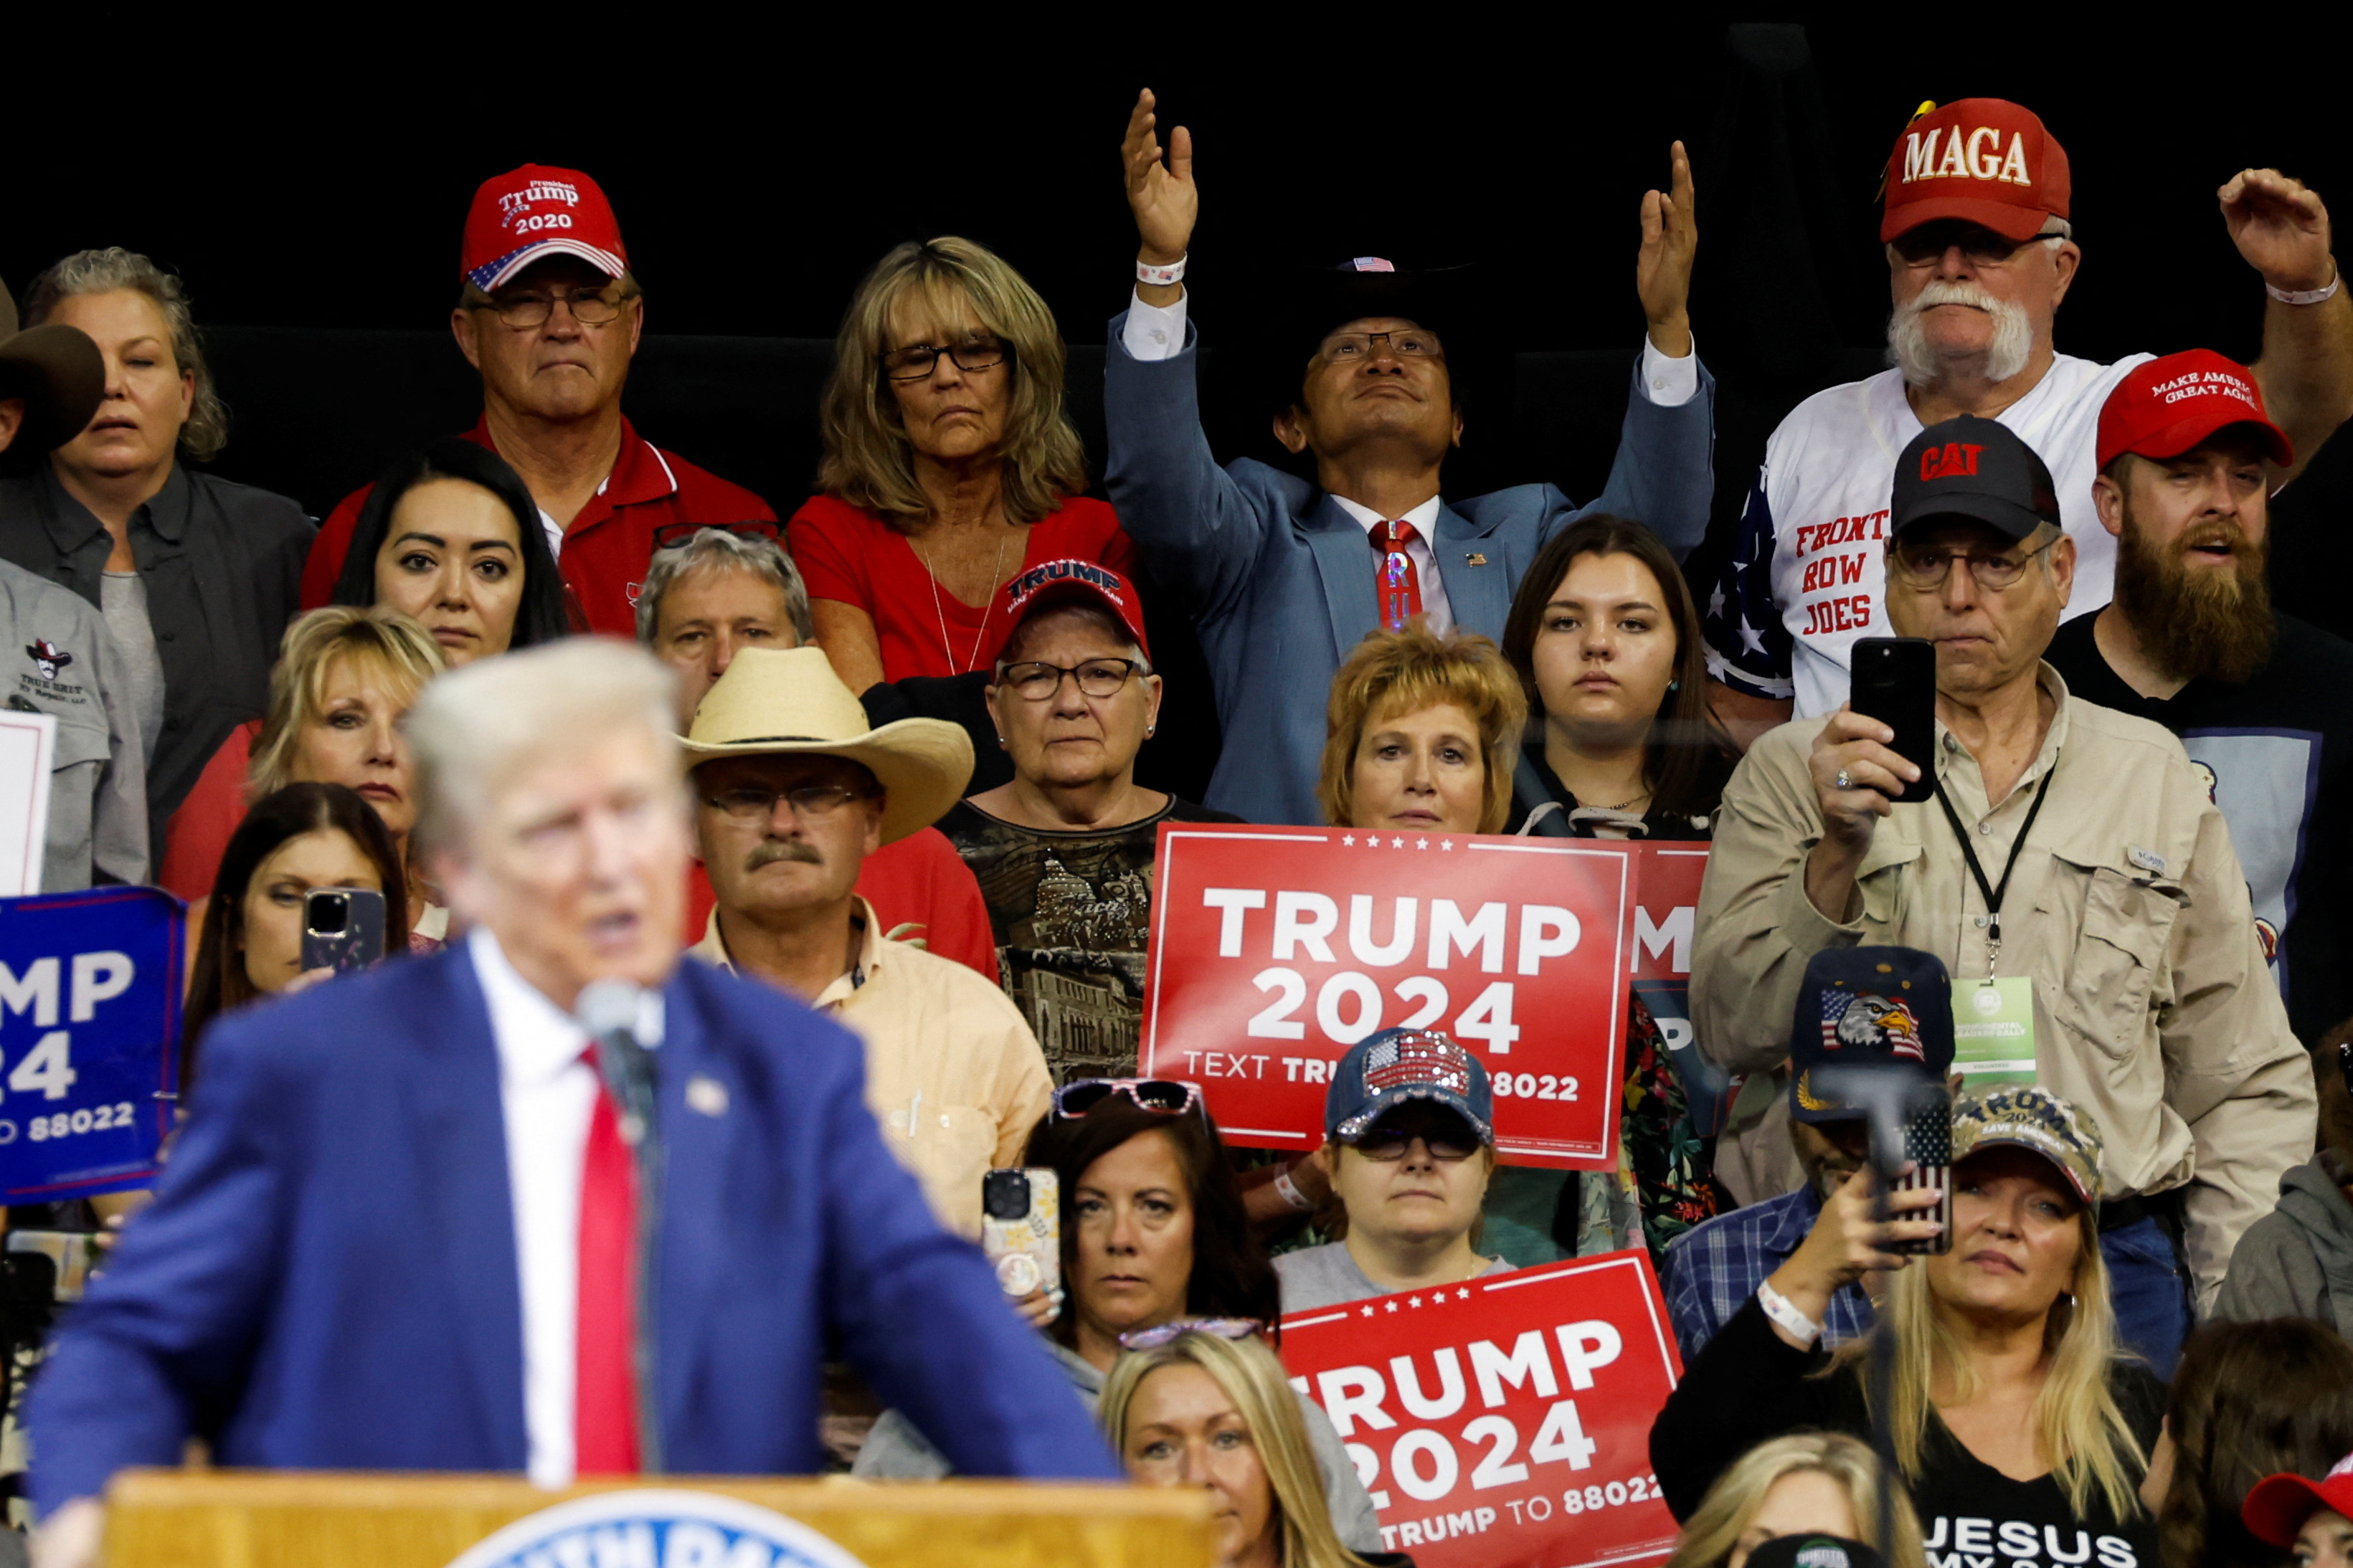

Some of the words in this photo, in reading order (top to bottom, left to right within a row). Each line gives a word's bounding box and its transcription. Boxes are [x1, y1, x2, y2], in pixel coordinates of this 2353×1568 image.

[1902, 124, 2031, 186] MAGA
[498, 186, 579, 212] Trump
[529, 180, 576, 190] President
[516, 214, 572, 235] 2020
[2152, 371, 2200, 397] MAKE
[2165, 385, 2218, 404] GREAT
[1920, 442, 1989, 482] CAT
[1796, 509, 1890, 558] FRONT
[1008, 563, 1120, 597] TRUMP
[1802, 552, 1867, 594] ROW
[1802, 594, 1870, 635] JOES
[20, 673, 50, 688] TRUE
[1203, 888, 1579, 975] TRUMP
[1247, 967, 1520, 1054] 2024
[1183, 1050, 1270, 1080] TEXT
[1487, 1071, 1578, 1101] 8022
[28, 1102, 135, 1142] 88022
[1982, 1123, 2012, 1135] SAVE
[1288, 1319, 1622, 1436] RUMP
[1344, 1399, 1596, 1510] 2024
[1379, 1506, 1497, 1551] TRUMP
[1505, 1496, 1552, 1525] TO
[1922, 1516, 2138, 1568] JESUS
